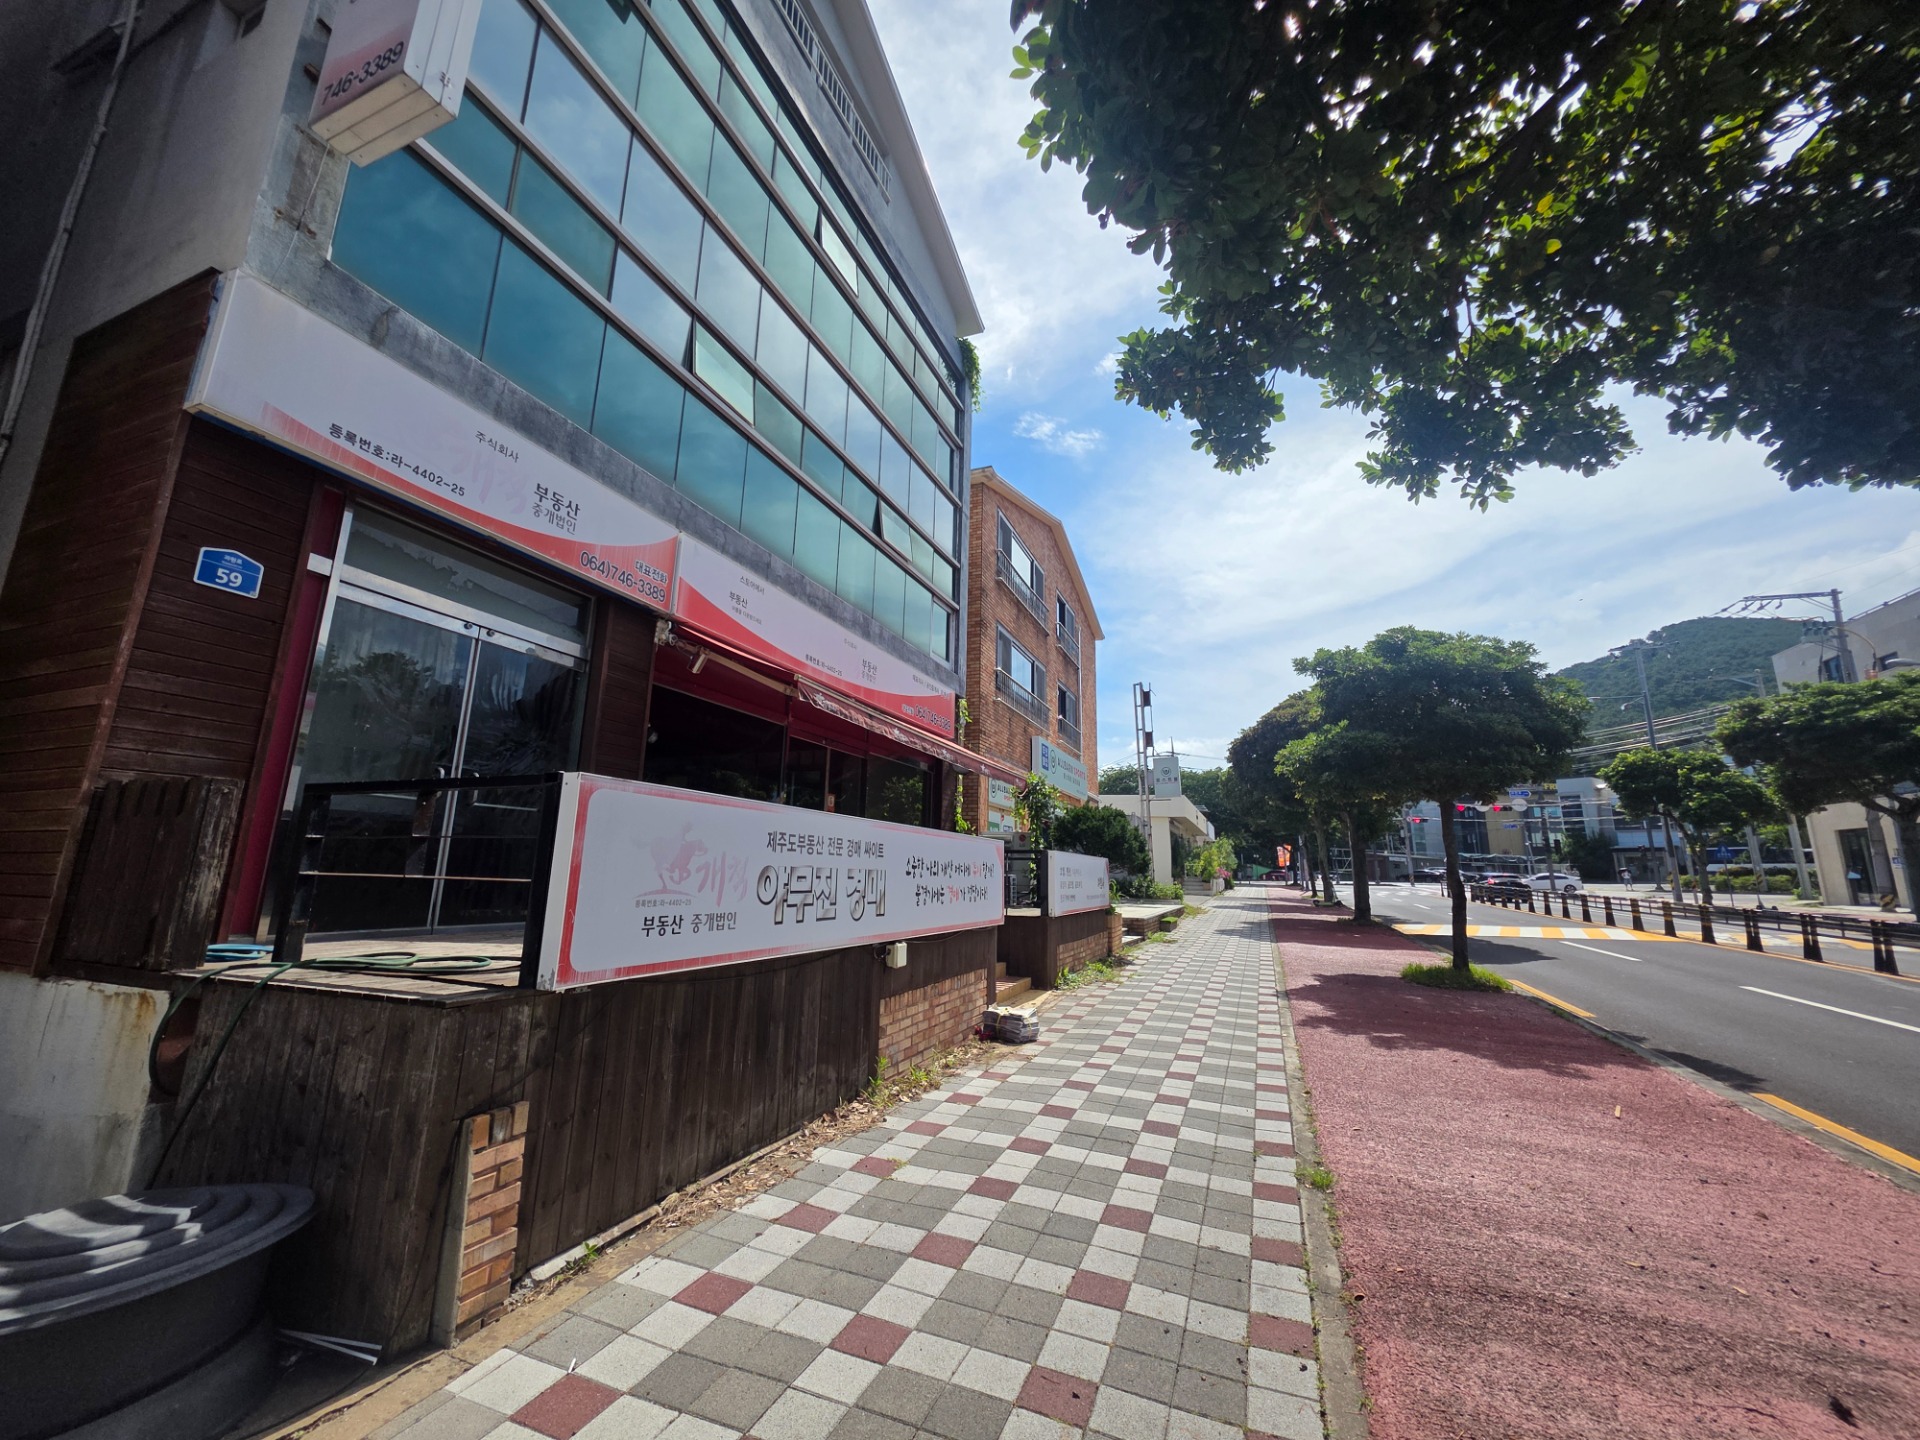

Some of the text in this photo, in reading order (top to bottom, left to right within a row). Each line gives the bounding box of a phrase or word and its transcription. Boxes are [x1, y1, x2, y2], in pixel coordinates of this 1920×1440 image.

[322, 41, 404, 105] 746-3389
[329, 423, 465, 497] 등록번호:라-4402-25
[475, 430, 519, 463] 주식회사
[534, 483, 581, 521] 부동산
[531, 502, 576, 535] 중개법인
[215, 567, 243, 588] 59
[580, 551, 666, 603] 064)746-3389
[635, 560, 668, 585] 대표전화
[729, 591, 748, 609] 부동산
[862, 658, 878, 676] 부동산
[767, 831, 884, 859] 제주도부동산 전문 경매 싸이트
[926, 860, 940, 877] 나의
[756, 865, 886, 925] 야무진 경매
[641, 912, 737, 937] 부동산 중개법인
